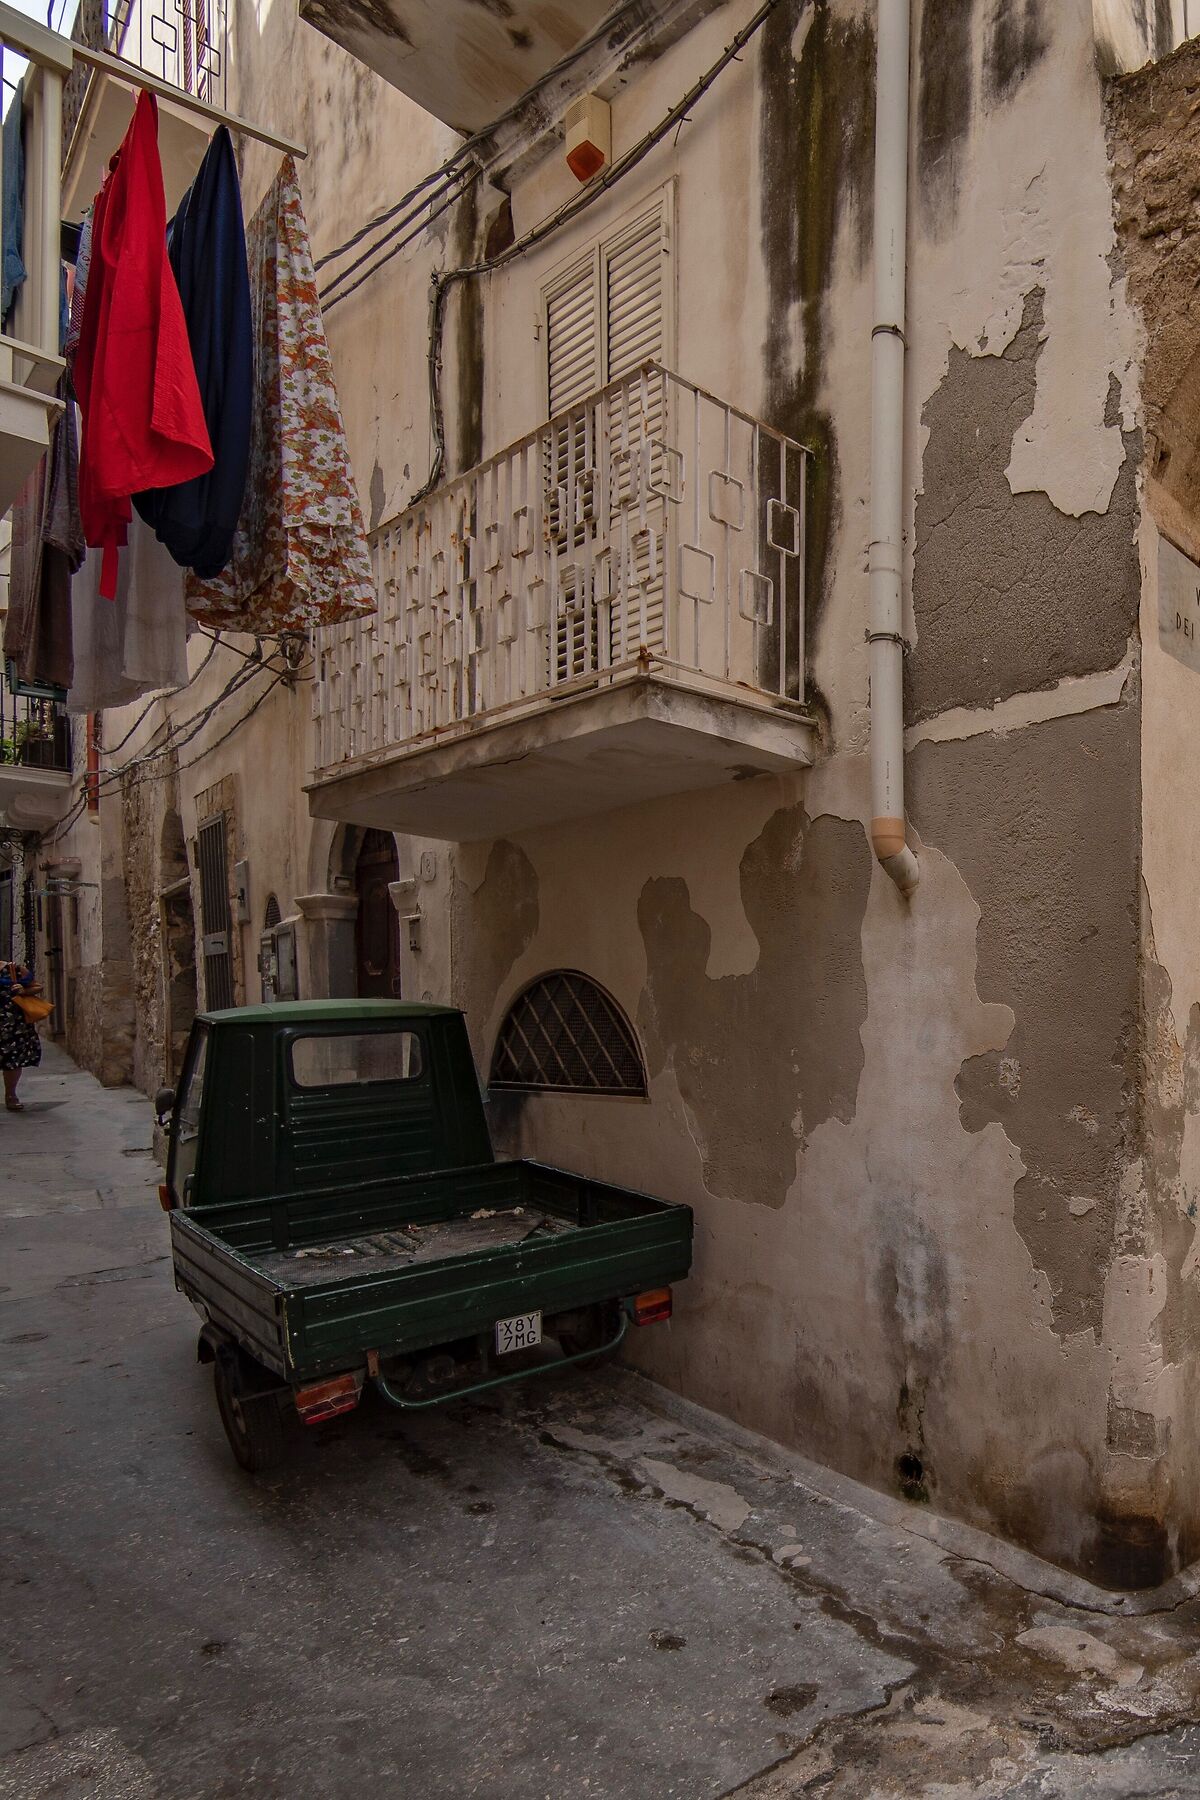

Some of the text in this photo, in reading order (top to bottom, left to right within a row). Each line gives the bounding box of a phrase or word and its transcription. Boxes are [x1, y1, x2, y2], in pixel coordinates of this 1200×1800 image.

[1176, 612, 1194, 640] DEI
[504, 1315, 535, 1336] X8Y
[504, 1331, 536, 1351] 7MG
